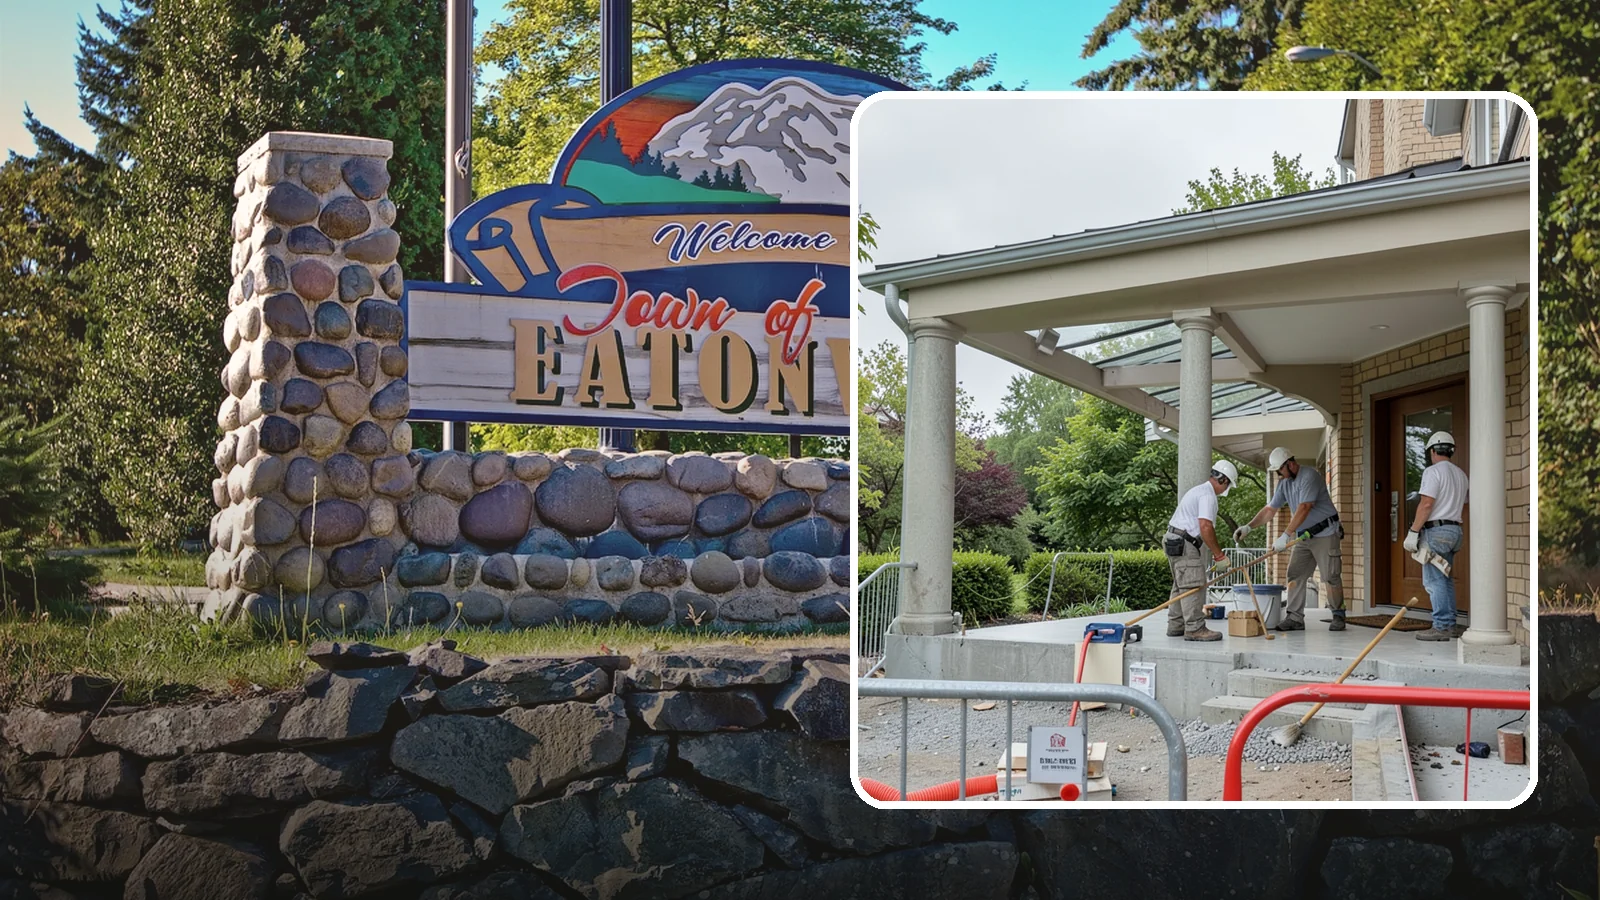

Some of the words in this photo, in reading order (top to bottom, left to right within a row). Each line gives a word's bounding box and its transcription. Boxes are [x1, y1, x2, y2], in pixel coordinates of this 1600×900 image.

[653, 220, 837, 264] Welcome
[556, 263, 736, 336] Town
[764, 278, 826, 365] of
